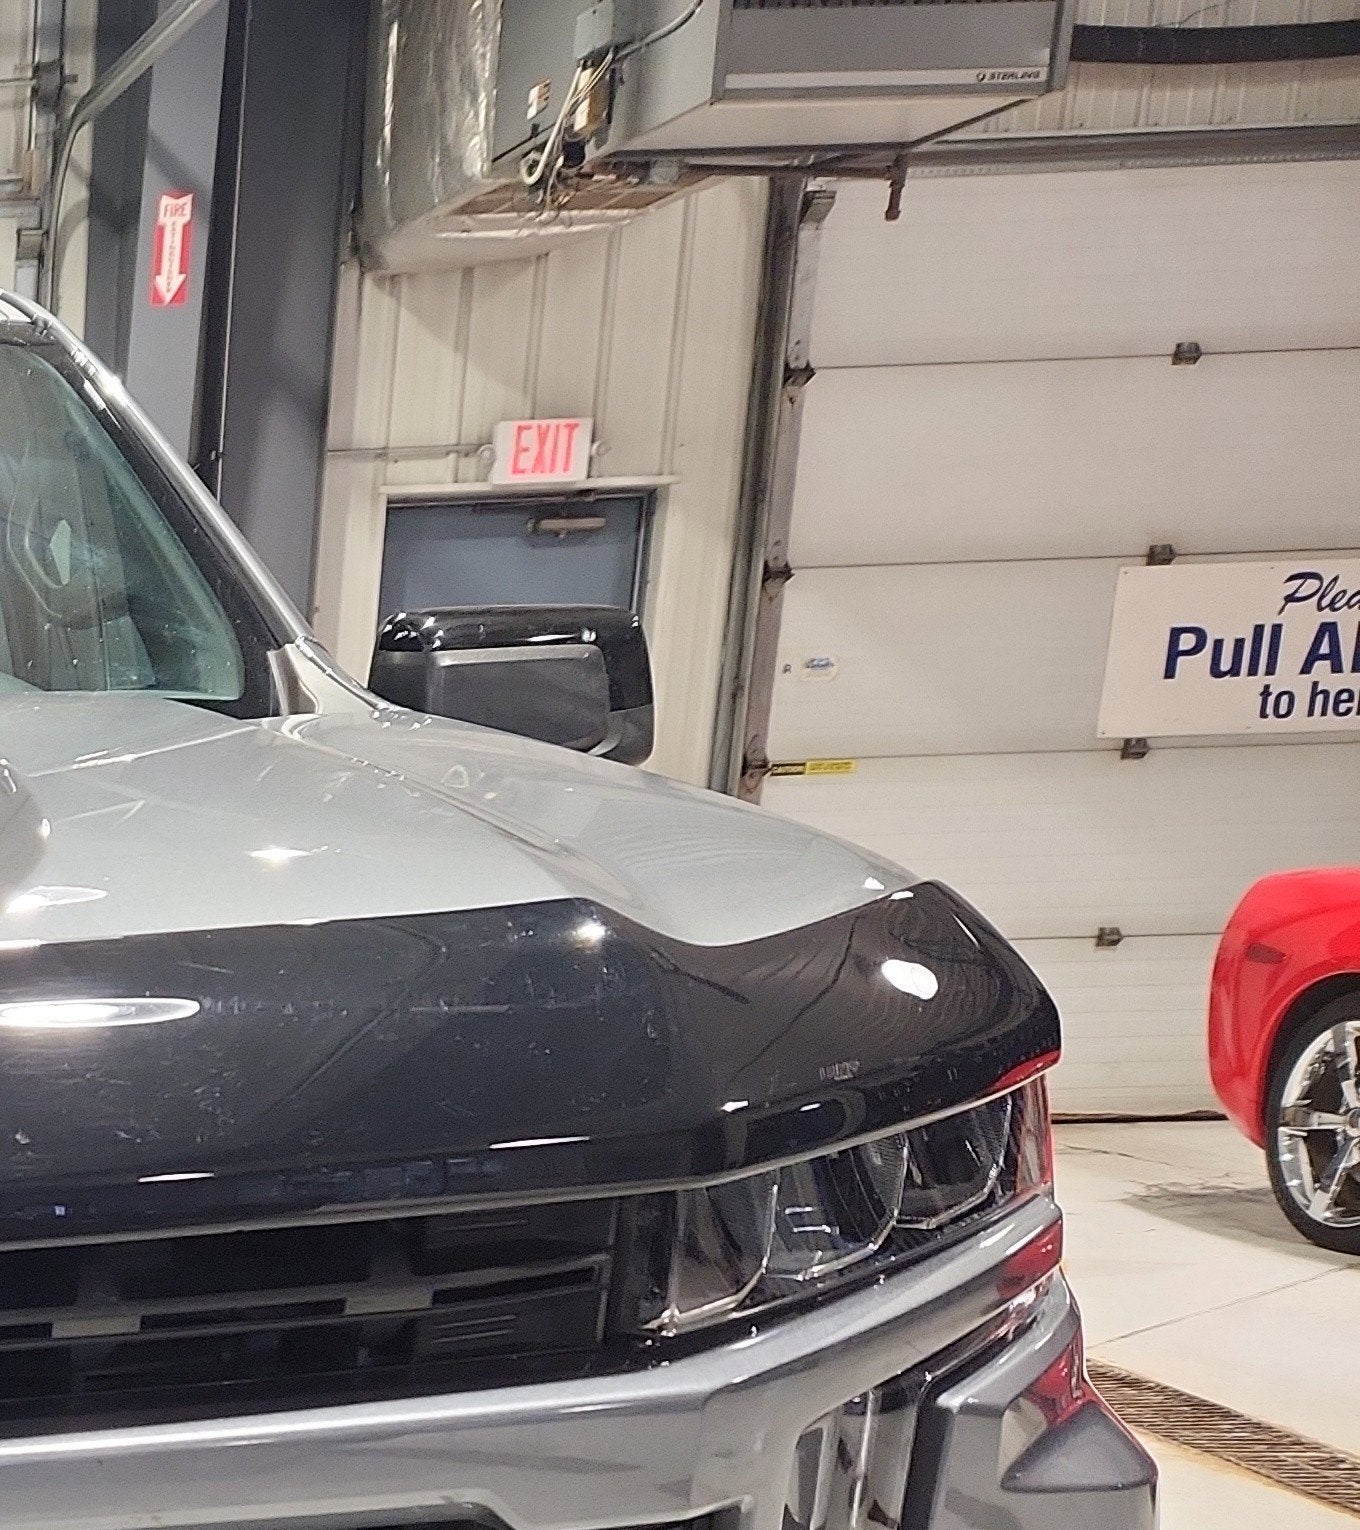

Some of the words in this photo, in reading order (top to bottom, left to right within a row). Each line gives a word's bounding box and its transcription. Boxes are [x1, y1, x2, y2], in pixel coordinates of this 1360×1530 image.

[163, 202, 188, 218] FIRE
[511, 422, 580, 475] EXIT
[1163, 623, 1284, 680] Pull
[1259, 683, 1296, 719] to
[1307, 680, 1360, 718] he
